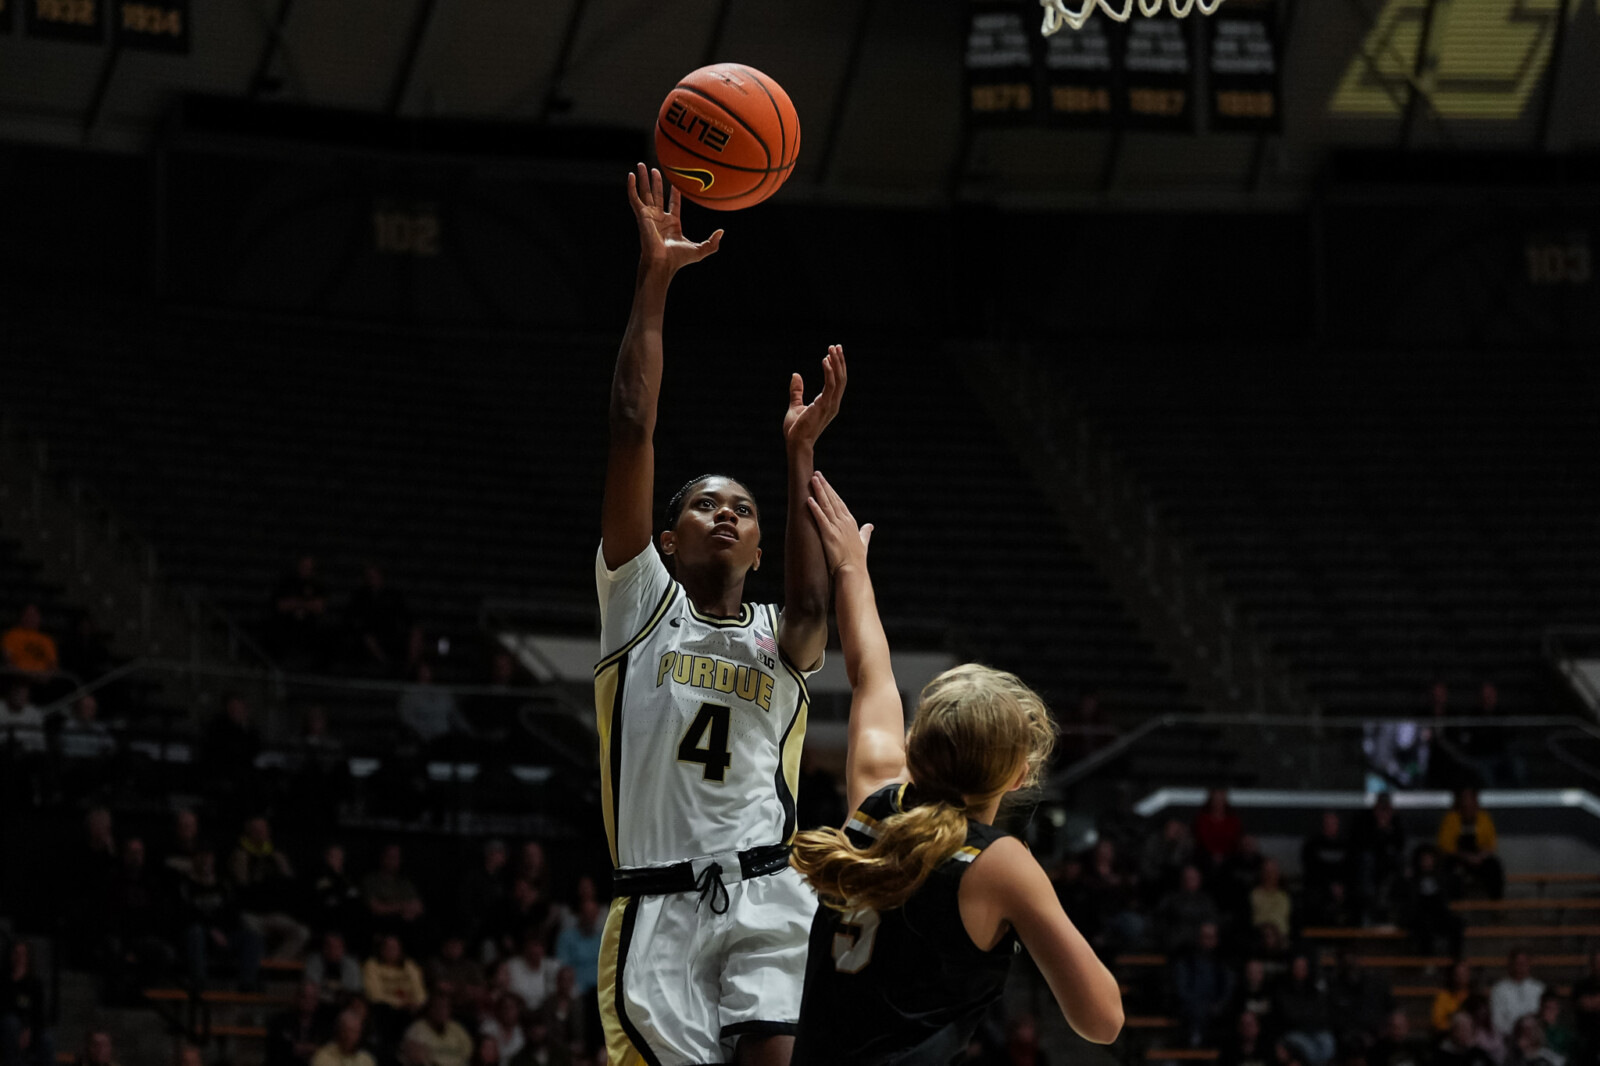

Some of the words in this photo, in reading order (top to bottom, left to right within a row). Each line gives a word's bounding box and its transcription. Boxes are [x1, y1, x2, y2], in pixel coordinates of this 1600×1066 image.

[121, 3, 182, 37] 1934
[665, 101, 731, 153] ELITE
[375, 212, 439, 255] 102
[1525, 246, 1591, 284] 103
[656, 650, 775, 713] PURDUE
[677, 702, 732, 784] 4
